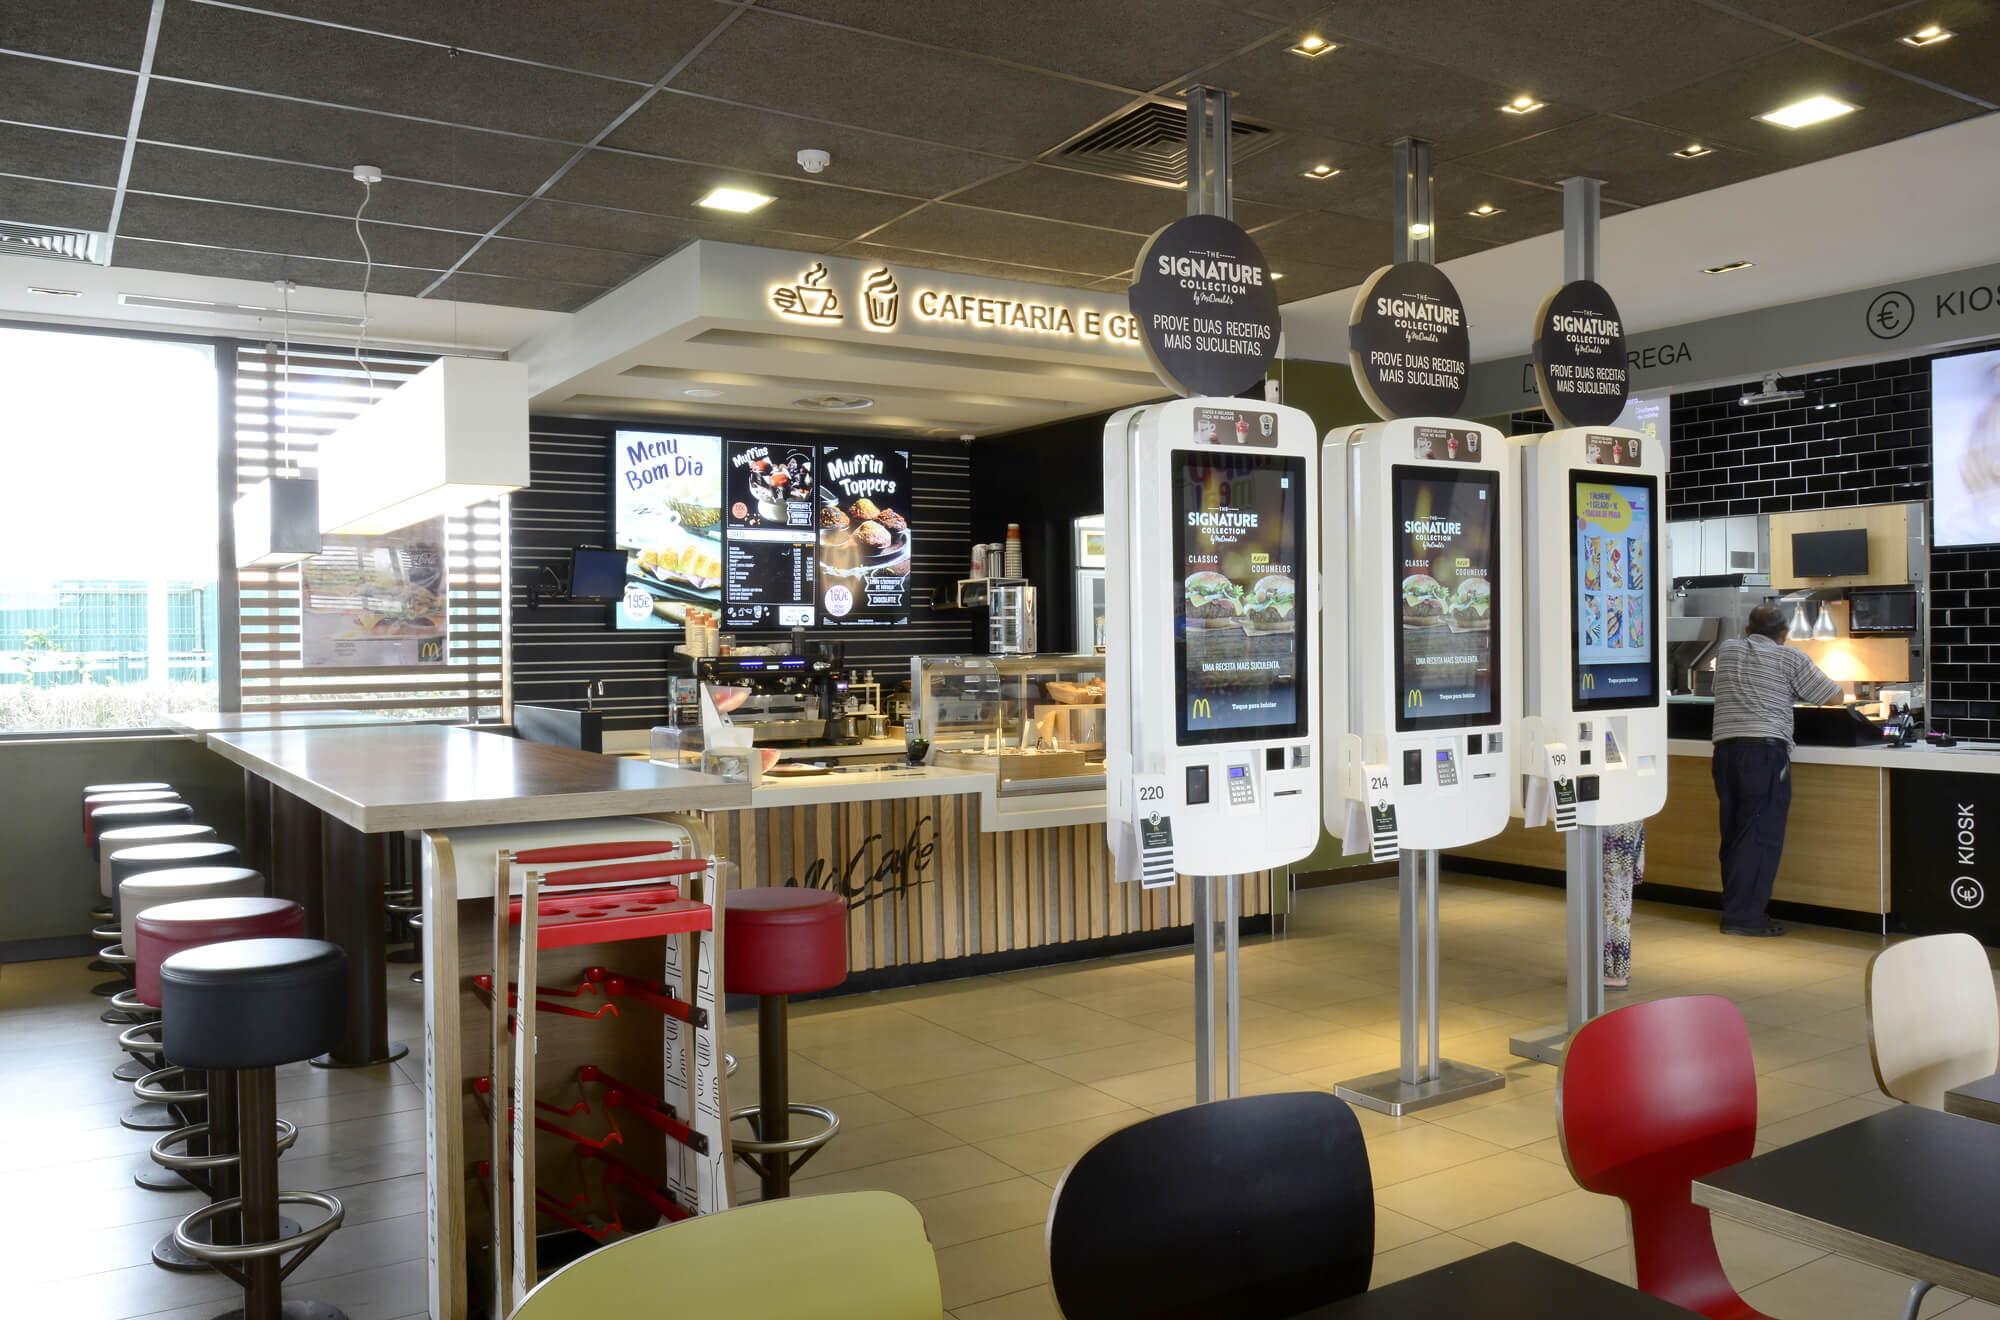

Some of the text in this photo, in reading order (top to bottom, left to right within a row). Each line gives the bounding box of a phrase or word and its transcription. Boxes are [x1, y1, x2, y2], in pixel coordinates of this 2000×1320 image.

[1158, 255, 1263, 286] SIGNATURE
[1180, 280, 1246, 295] COLLECTION
[1193, 292, 1234, 305] by McDonald's
[918, 291, 1075, 333] CAFETARIA
[1084, 311, 1100, 336] E
[1377, 297, 1460, 328] SIGNATURE
[1153, 314, 1271, 340] PROVE DUAS RECEITAS
[1394, 320, 1448, 335] COLLECTION
[1552, 315, 1620, 338] SIGNATURE
[1164, 334, 1263, 356] MAIS SUCULENTAS.
[1411, 330, 1439, 343] McDonald's
[1566, 334, 1610, 346] COLLECTION
[1370, 351, 1465, 375] PROVE DUAS RECEITAS
[1379, 368, 1460, 391] MAIS SUCULENTAS.
[1550, 364, 1626, 382] PROVE DUAS RECEITAS
[1556, 380, 1621, 396] MAIS SUCULENTAS.
[626, 438, 678, 466] Menu
[732, 446, 769, 468] Muffins
[625, 456, 704, 491] Bom Dia
[827, 454, 884, 481] Muffin
[838, 478, 896, 498] Toppers
[1188, 512, 1258, 528] SIGNATURE
[1404, 521, 1461, 535] SIGNATURE
[1188, 555, 1218, 564] CLASSIC
[1251, 564, 1291, 574] COGUMELOS
[1202, 663, 1215, 672] UMA
[1215, 662, 1236, 671] RECEITA
[1236, 662, 1250, 671] MAIS
[1552, 754, 1566, 766] 199
[1371, 777, 1388, 790] 214
[1140, 785, 1164, 801] 220
[1957, 803, 1975, 865] KIOSK
